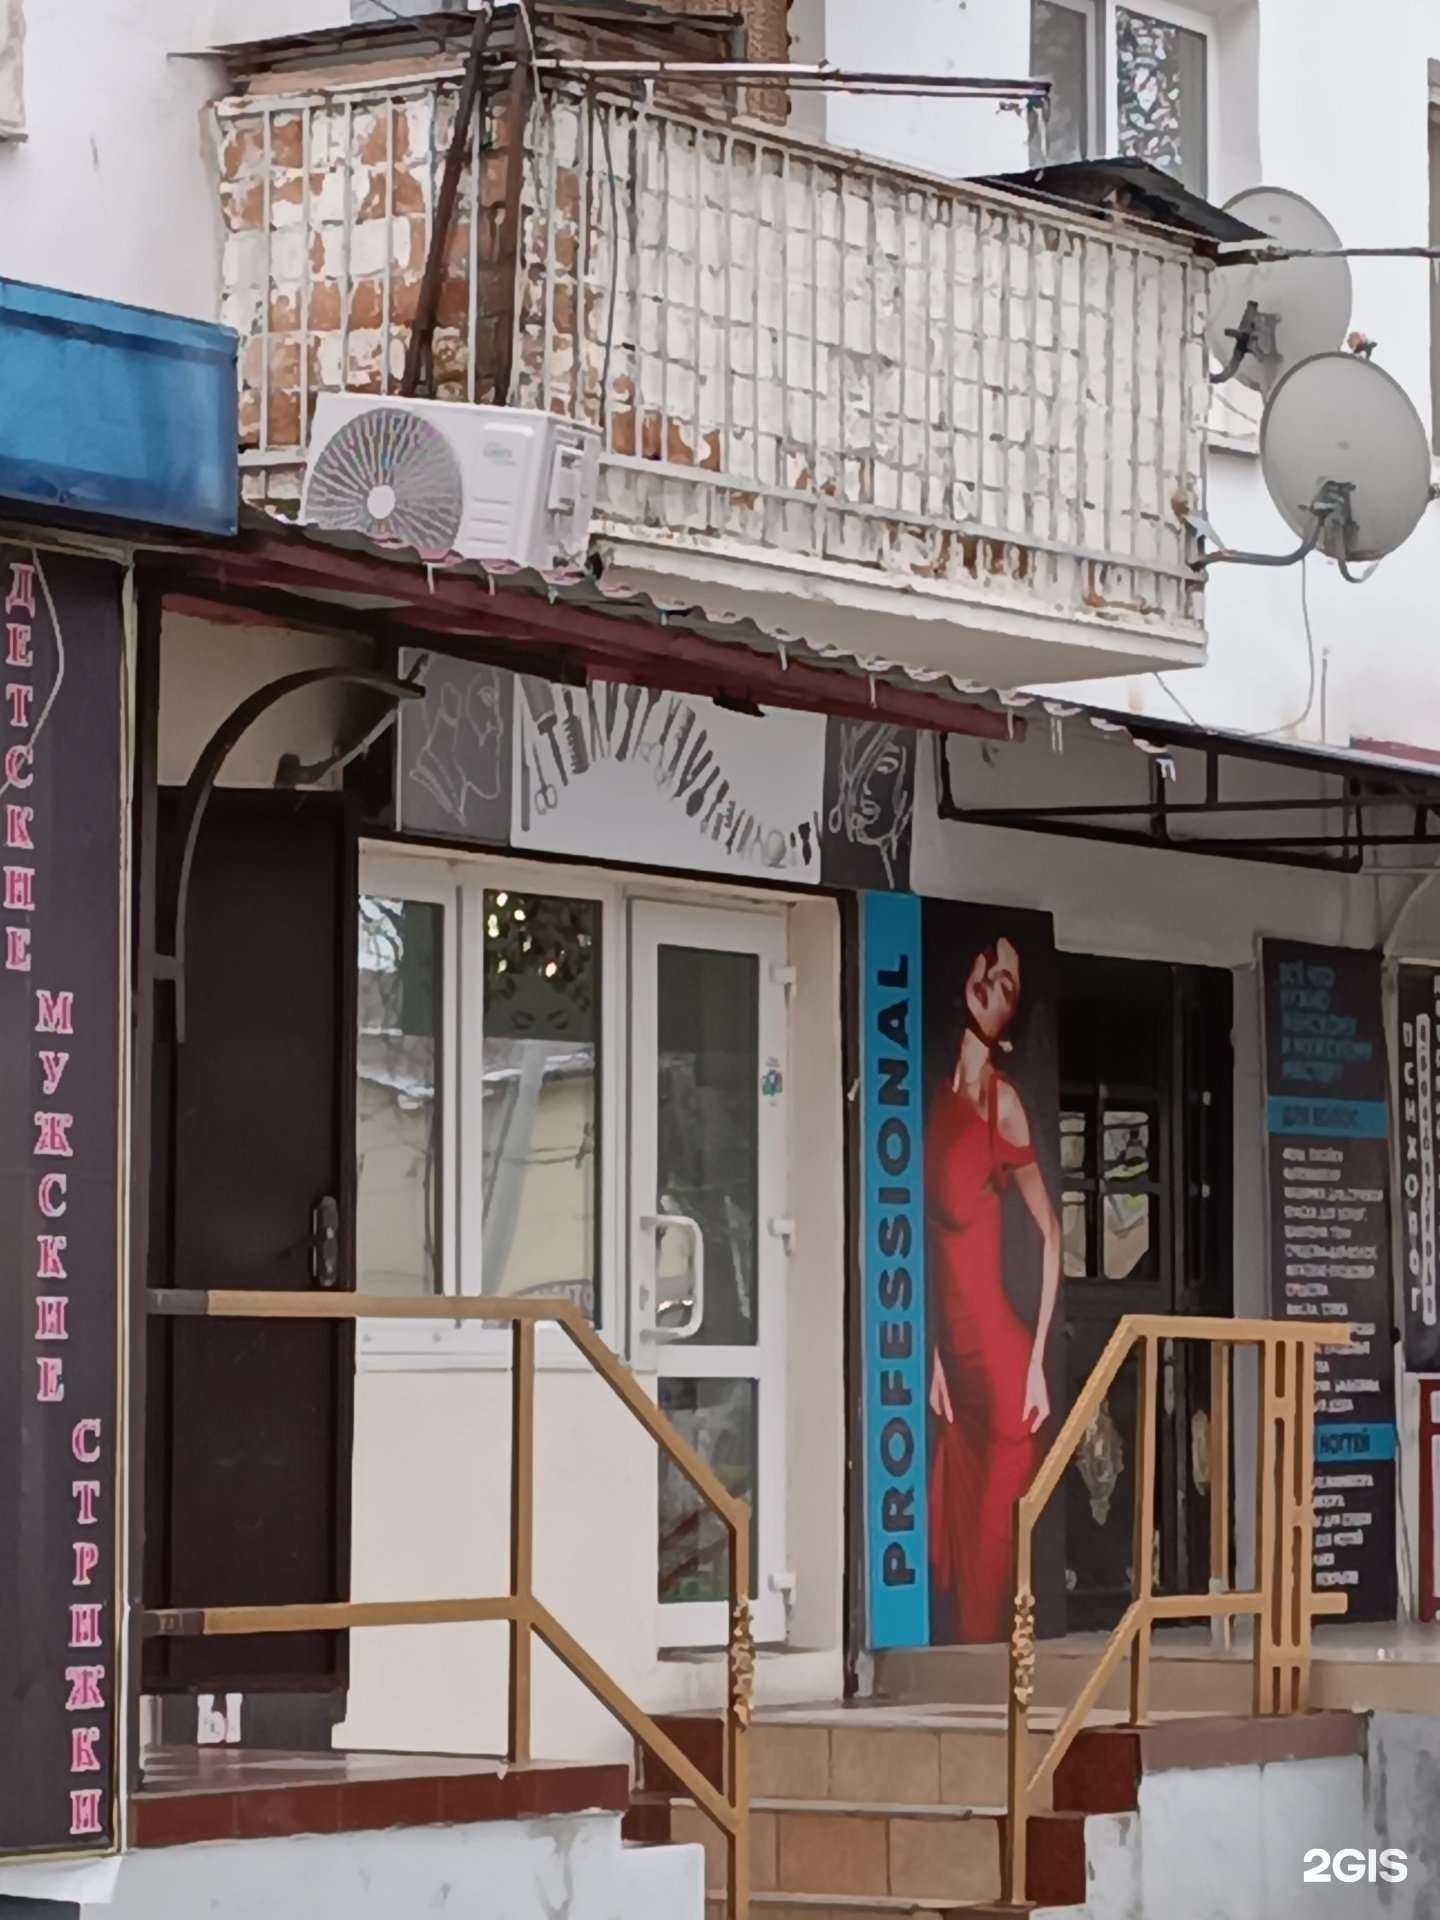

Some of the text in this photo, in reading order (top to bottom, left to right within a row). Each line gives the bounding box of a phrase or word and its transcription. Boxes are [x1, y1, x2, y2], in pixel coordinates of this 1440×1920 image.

[3, 562, 36, 972] ДЕТСКИЕ
[34, 990, 74, 1402] МУЖСКИЕ
[877, 954, 915, 1587] PROFESSIONAL
[65, 1419, 105, 1835] СТРИЖКИ
